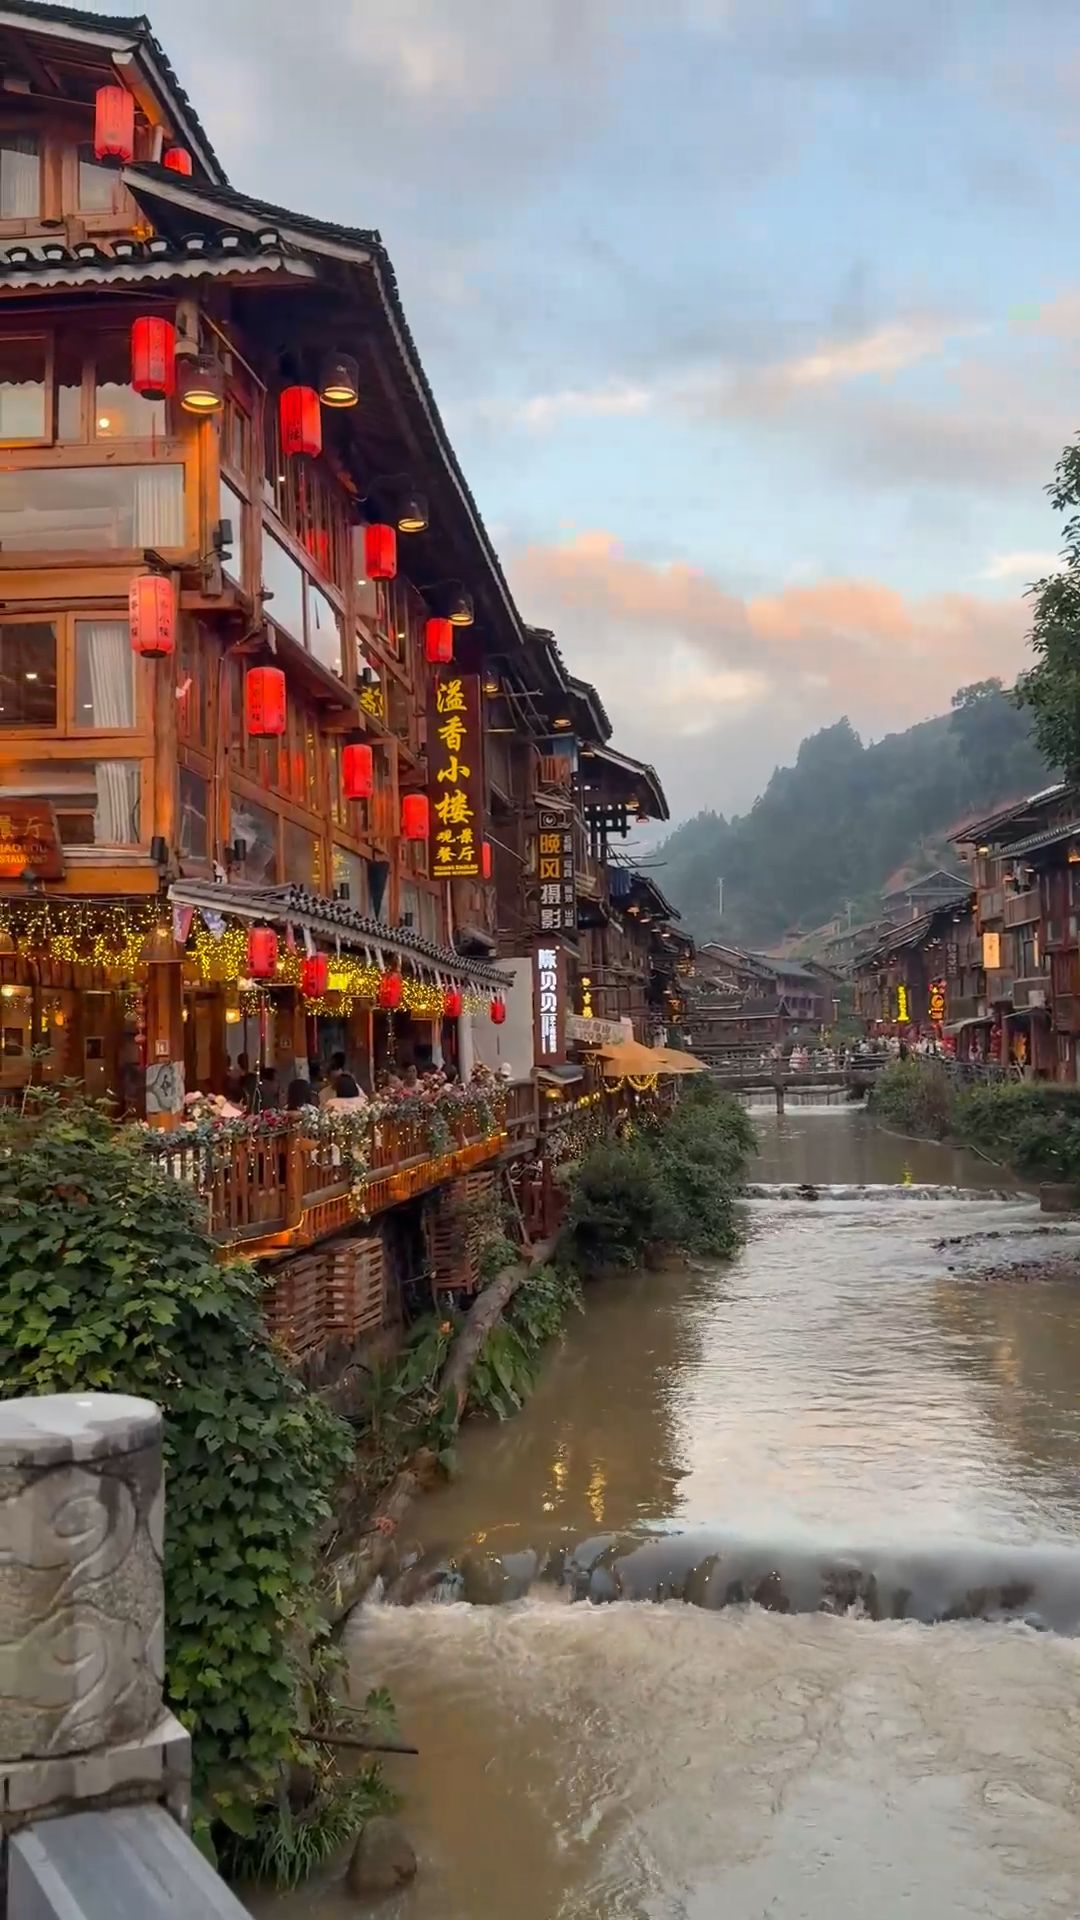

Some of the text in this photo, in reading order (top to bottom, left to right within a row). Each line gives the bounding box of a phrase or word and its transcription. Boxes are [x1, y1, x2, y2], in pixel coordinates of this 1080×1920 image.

[434, 679, 475, 825] 溢香小楼
[0, 843, 21, 854] IAO
[436, 846, 475, 863] 餐厅
[540, 833, 561, 929] 晚风摄影
